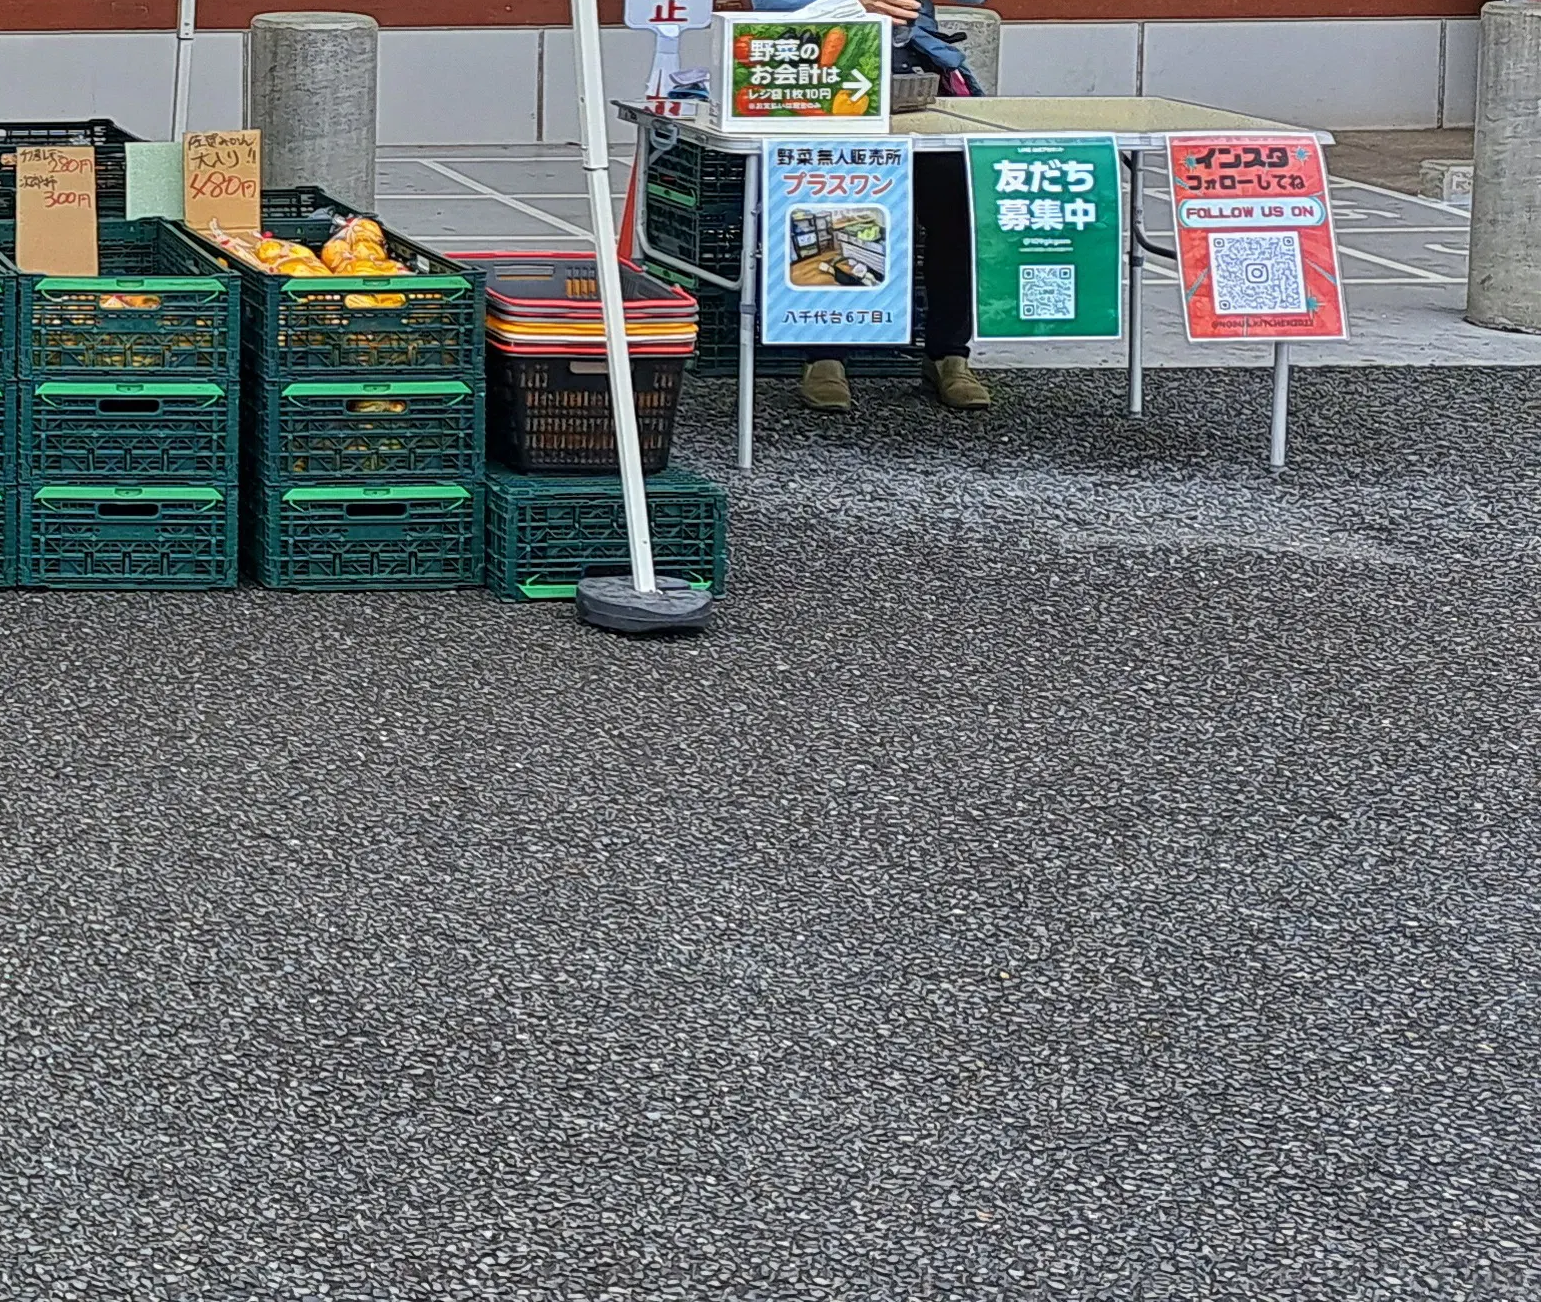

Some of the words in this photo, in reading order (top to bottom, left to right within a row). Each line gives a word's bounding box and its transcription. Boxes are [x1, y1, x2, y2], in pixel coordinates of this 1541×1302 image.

[749, 38, 820, 62] 野菜の
[750, 63, 841, 85] お会計は
[1195, 147, 1290, 169] インスタ
[190, 171, 256, 199] 480円
[783, 171, 893, 196] プラスワン
[993, 159, 1095, 193] 友だち
[1186, 174, 1306, 191] フォローしてね
[43, 191, 92, 209] 300円
[996, 197, 1096, 231] 募集中
[1186, 206, 1254, 219] FOLLOW
[1261, 206, 1284, 218] US
[1291, 205, 1315, 218] ON
